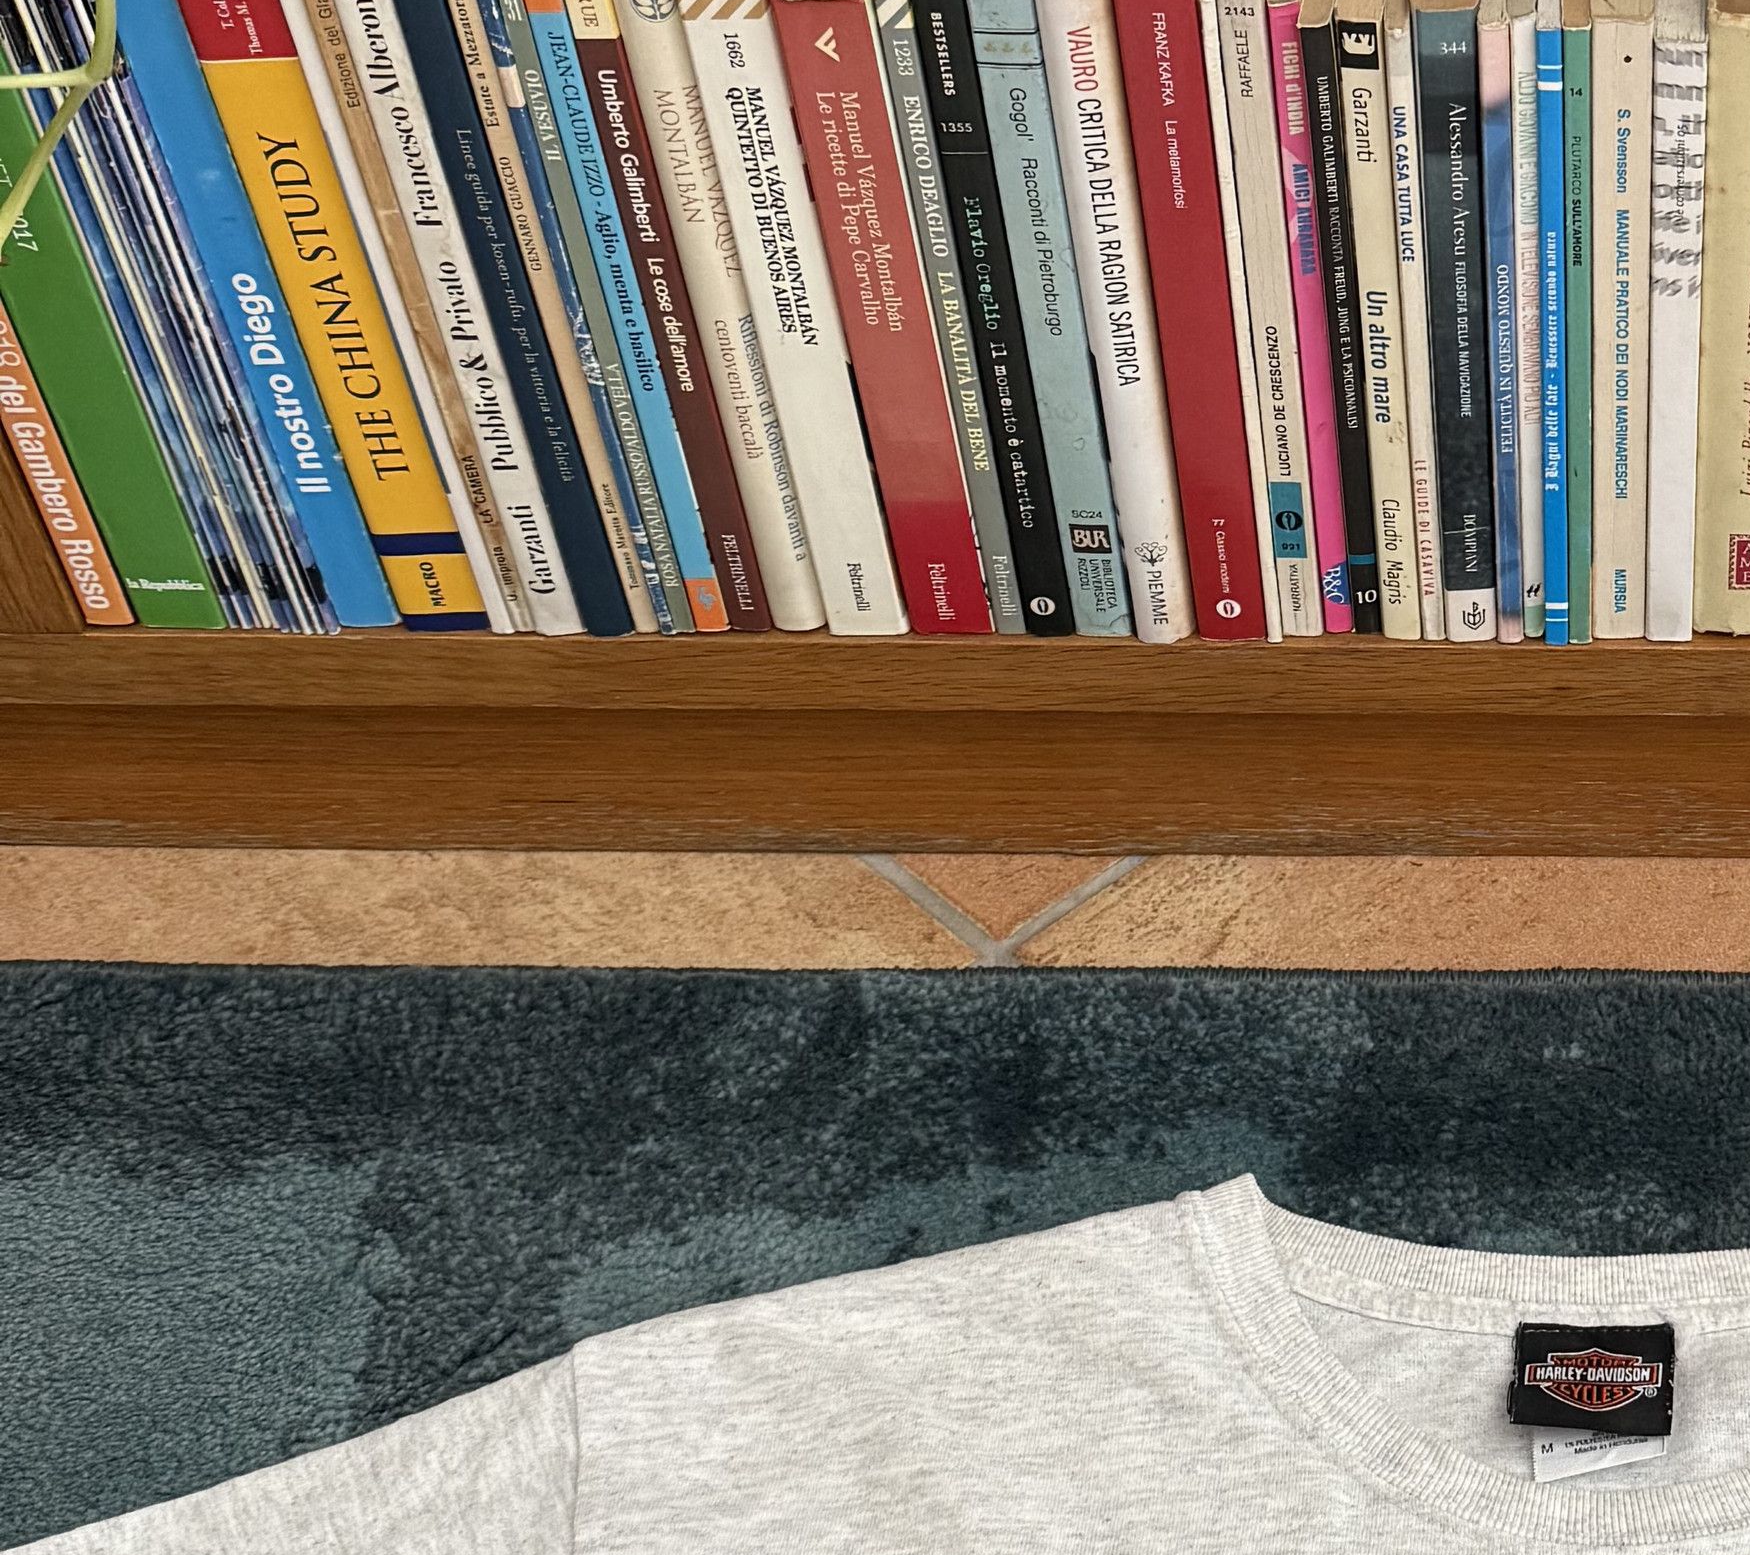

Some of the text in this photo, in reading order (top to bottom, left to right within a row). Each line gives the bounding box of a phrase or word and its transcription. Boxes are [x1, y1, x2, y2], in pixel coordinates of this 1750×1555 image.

[245, 17, 263, 55] Thomas
[1224, 6, 1256, 18] 2143
[724, 34, 746, 68] 1662
[1234, 30, 1254, 98] RAFFAELE
[940, 121, 974, 134] 1355
[1352, 88, 1377, 162] Garzanti
[392, 106, 442, 226] Francesco
[1022, 158, 1045, 226] Racconti
[598, 70, 694, 392] Umberto Galimberti Le cose dell'amore
[726, 88, 798, 332] QUINTETTO DI BUENOS AIRES
[746, 88, 818, 346] MANUEL VÁZQUEZ MONTALBÁN
[816, 92, 881, 325] Le ricette di Pepe Carvalho
[840, 92, 904, 332] Manuel Vázquez Montalbán
[1034, 230, 1050, 244] di
[1068, 26, 1140, 386] VAURO CRITICA DELLA RAGION SATIRICA
[258, 134, 409, 480] THE CHINA STUDY
[1038, 250, 1062, 336] Pietroburgo
[1616, 108, 1632, 498] S. Svensson MANUALE PRATICO DEI NODI MARINARESCHI
[232, 274, 332, 492] Il nostro Diego
[1366, 290, 1391, 424] Un altro mare
[1266, 326, 1291, 476] LUCIANO DE CRESCENZO
[138, 578, 205, 592] Repubblica
[420, 561, 446, 607] MACRO
[508, 506, 555, 594] Garzanti
[1382, 500, 1406, 604] Claudio Magris
[1147, 570, 1168, 625] PIEMME
[1355, 589, 1377, 605] 10
[1614, 568, 1626, 614] MURSIA
[1535, 1364, 1651, 1382] HARLEY-DAVIDSON
[1559, 1384, 1625, 1404] CYCLES
[1541, 1442, 1554, 1454] M
